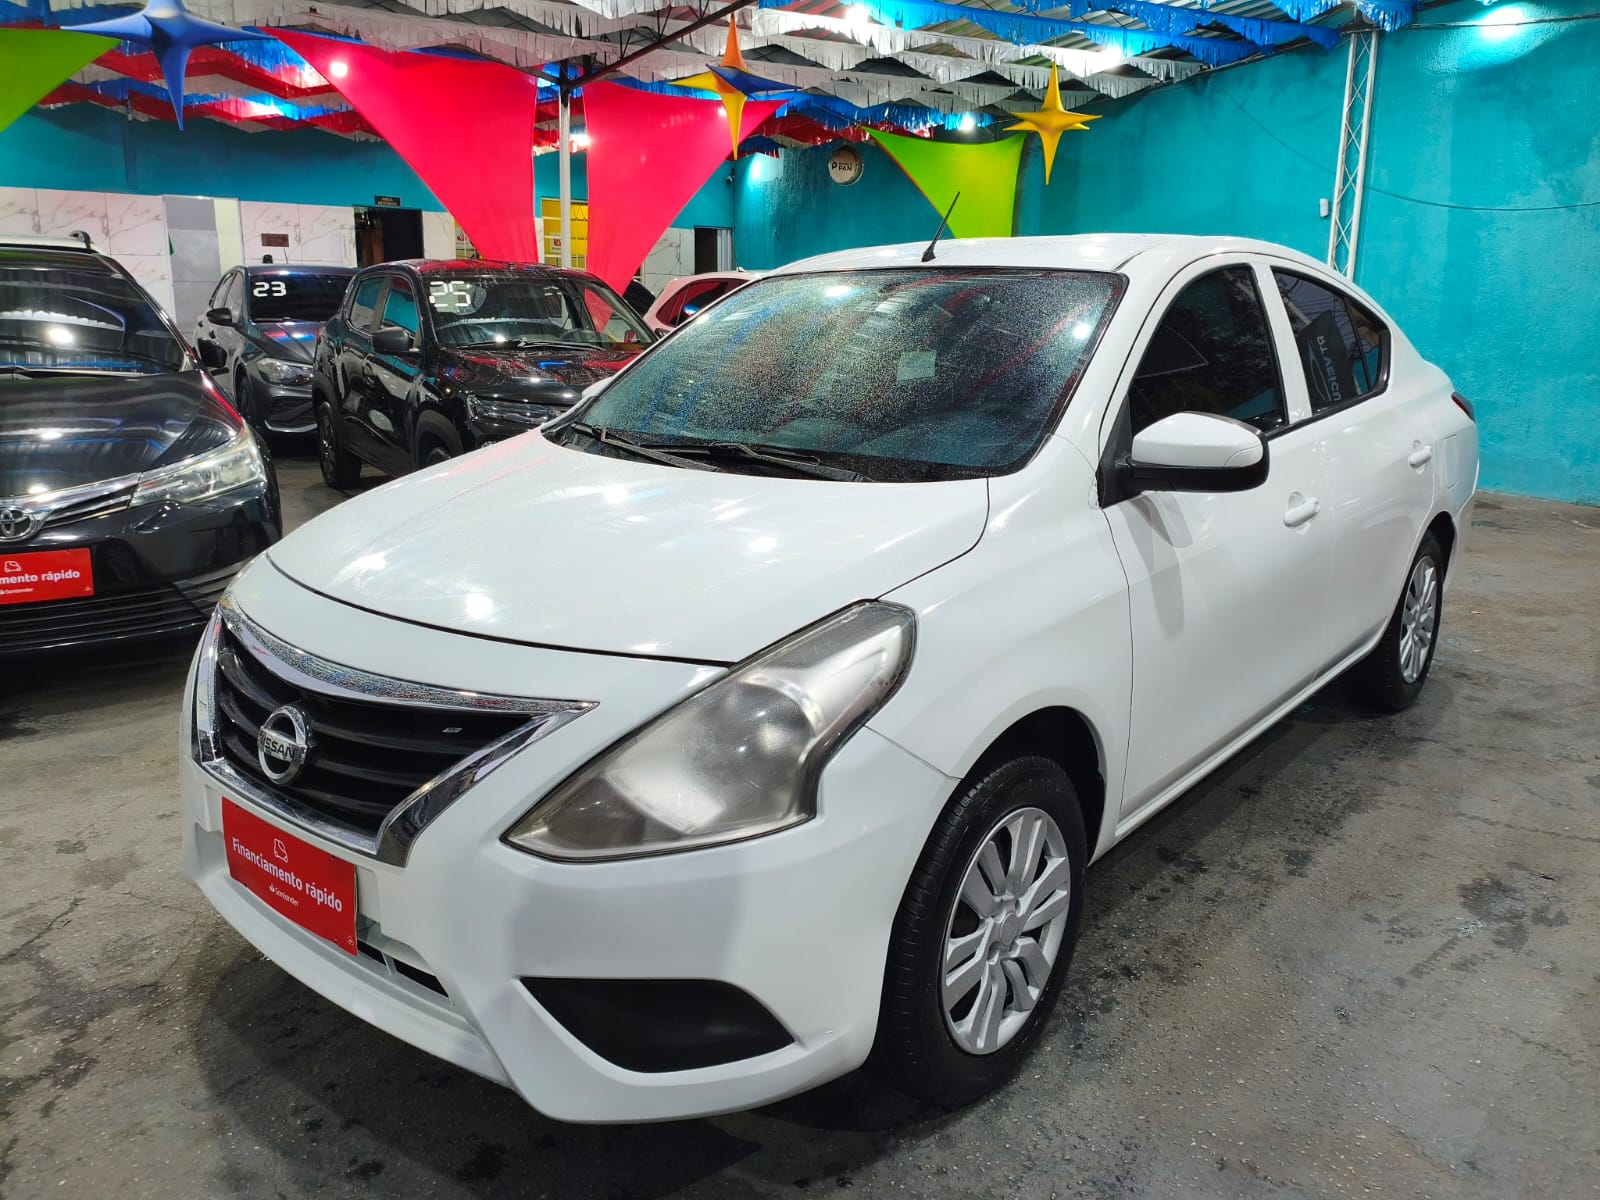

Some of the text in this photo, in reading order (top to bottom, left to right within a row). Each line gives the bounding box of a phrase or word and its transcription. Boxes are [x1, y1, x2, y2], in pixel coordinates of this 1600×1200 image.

[253, 282, 287, 297] 23
[429, 281, 471, 307] 25
[41, 569, 80, 582] rápido
[232, 837, 343, 912] Financiamento rápido
[275, 888, 299, 907] Santander
